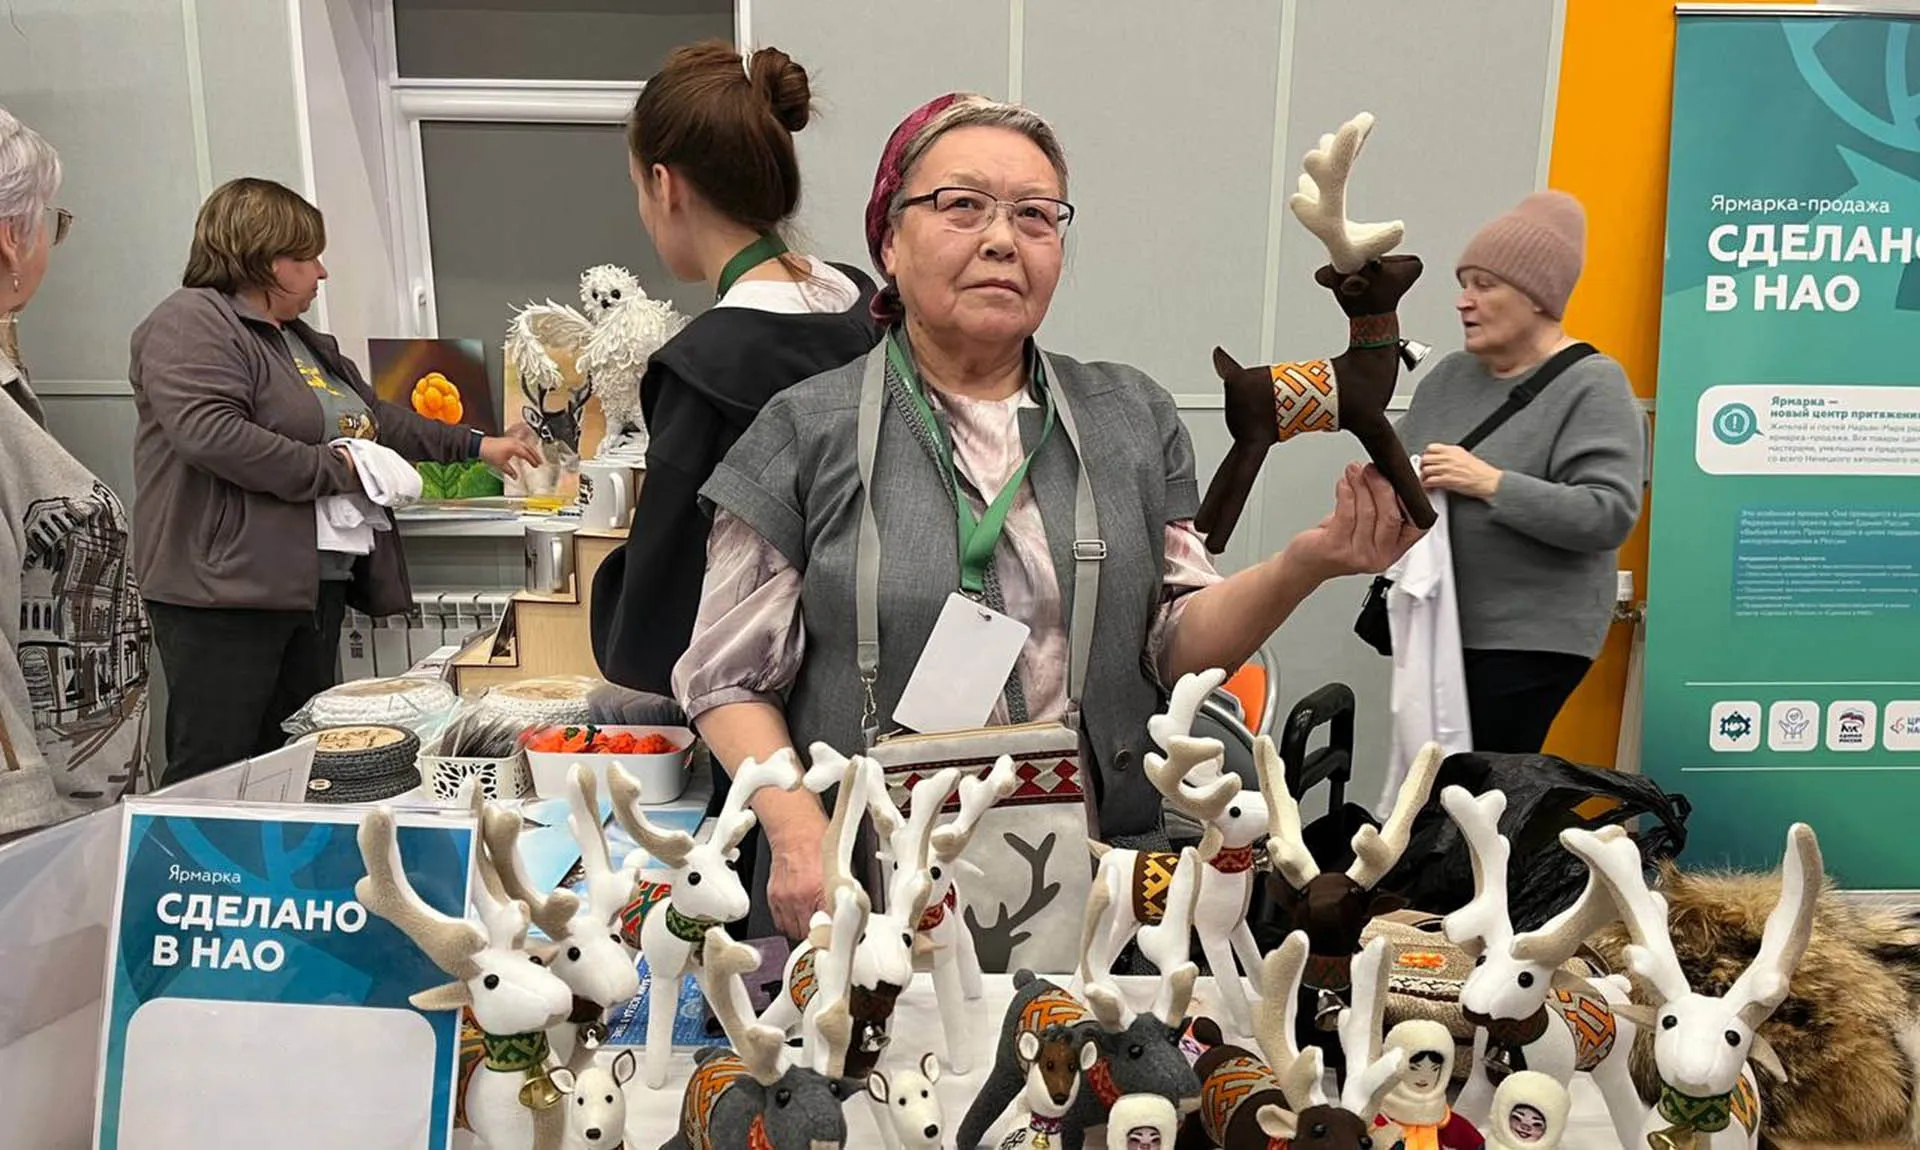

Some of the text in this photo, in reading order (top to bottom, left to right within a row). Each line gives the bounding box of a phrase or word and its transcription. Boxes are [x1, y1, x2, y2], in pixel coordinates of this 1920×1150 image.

[1710, 195, 1890, 214] Ярмарка-продажа
[1708, 224, 1920, 268] СДЕЛАН
[1705, 274, 1860, 312] В НАО
[1770, 408, 1809, 418] новый
[1812, 410, 1849, 420] центр
[1772, 396, 1825, 408] Ярмарка
[168, 864, 241, 884] Ярмарка
[156, 893, 367, 933] СДЕЛАНО
[152, 935, 285, 972] В НАО
